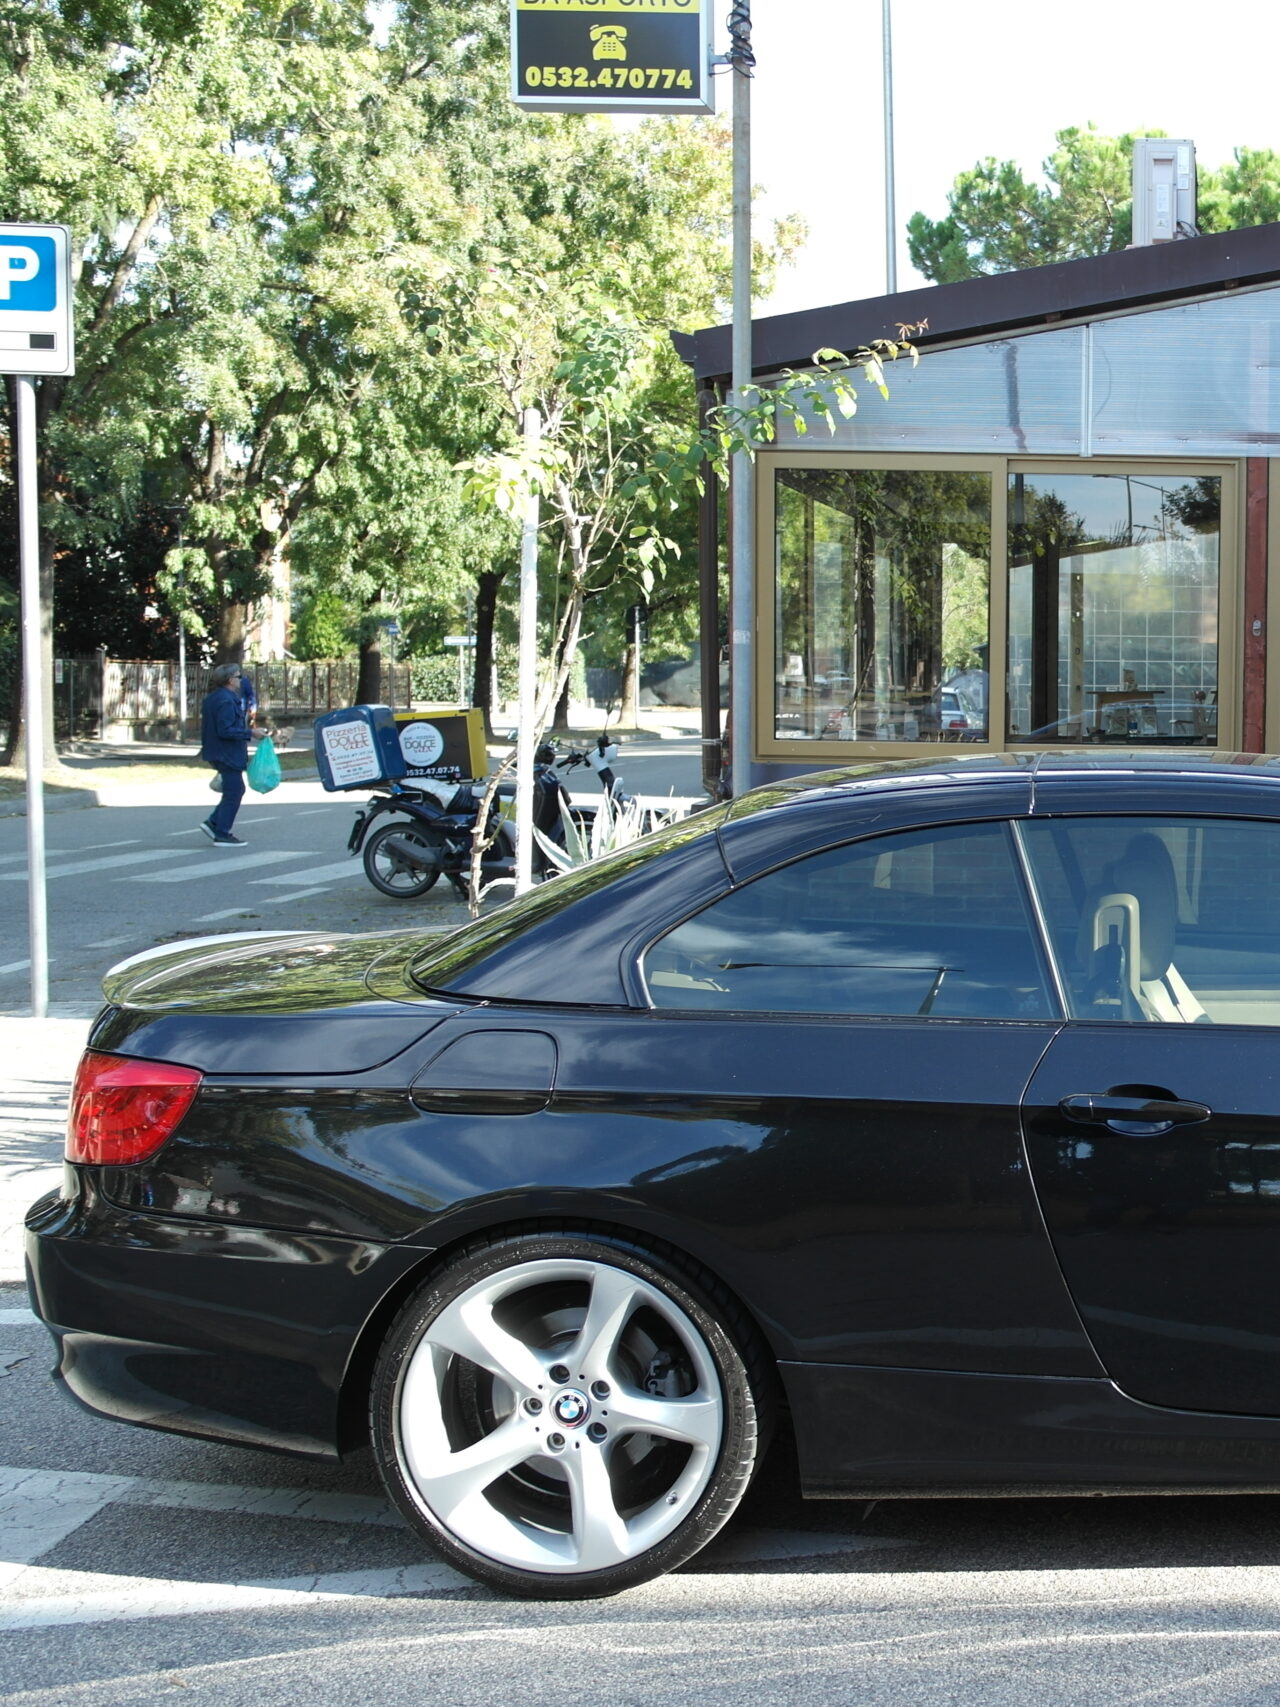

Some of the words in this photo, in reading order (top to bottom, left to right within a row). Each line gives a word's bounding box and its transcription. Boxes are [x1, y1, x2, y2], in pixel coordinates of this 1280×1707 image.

[525, 66, 693, 89] 0532.470774
[0, 245, 40, 300] P
[326, 725, 367, 738] Pizzeria
[404, 739, 436, 750] DOLCE
